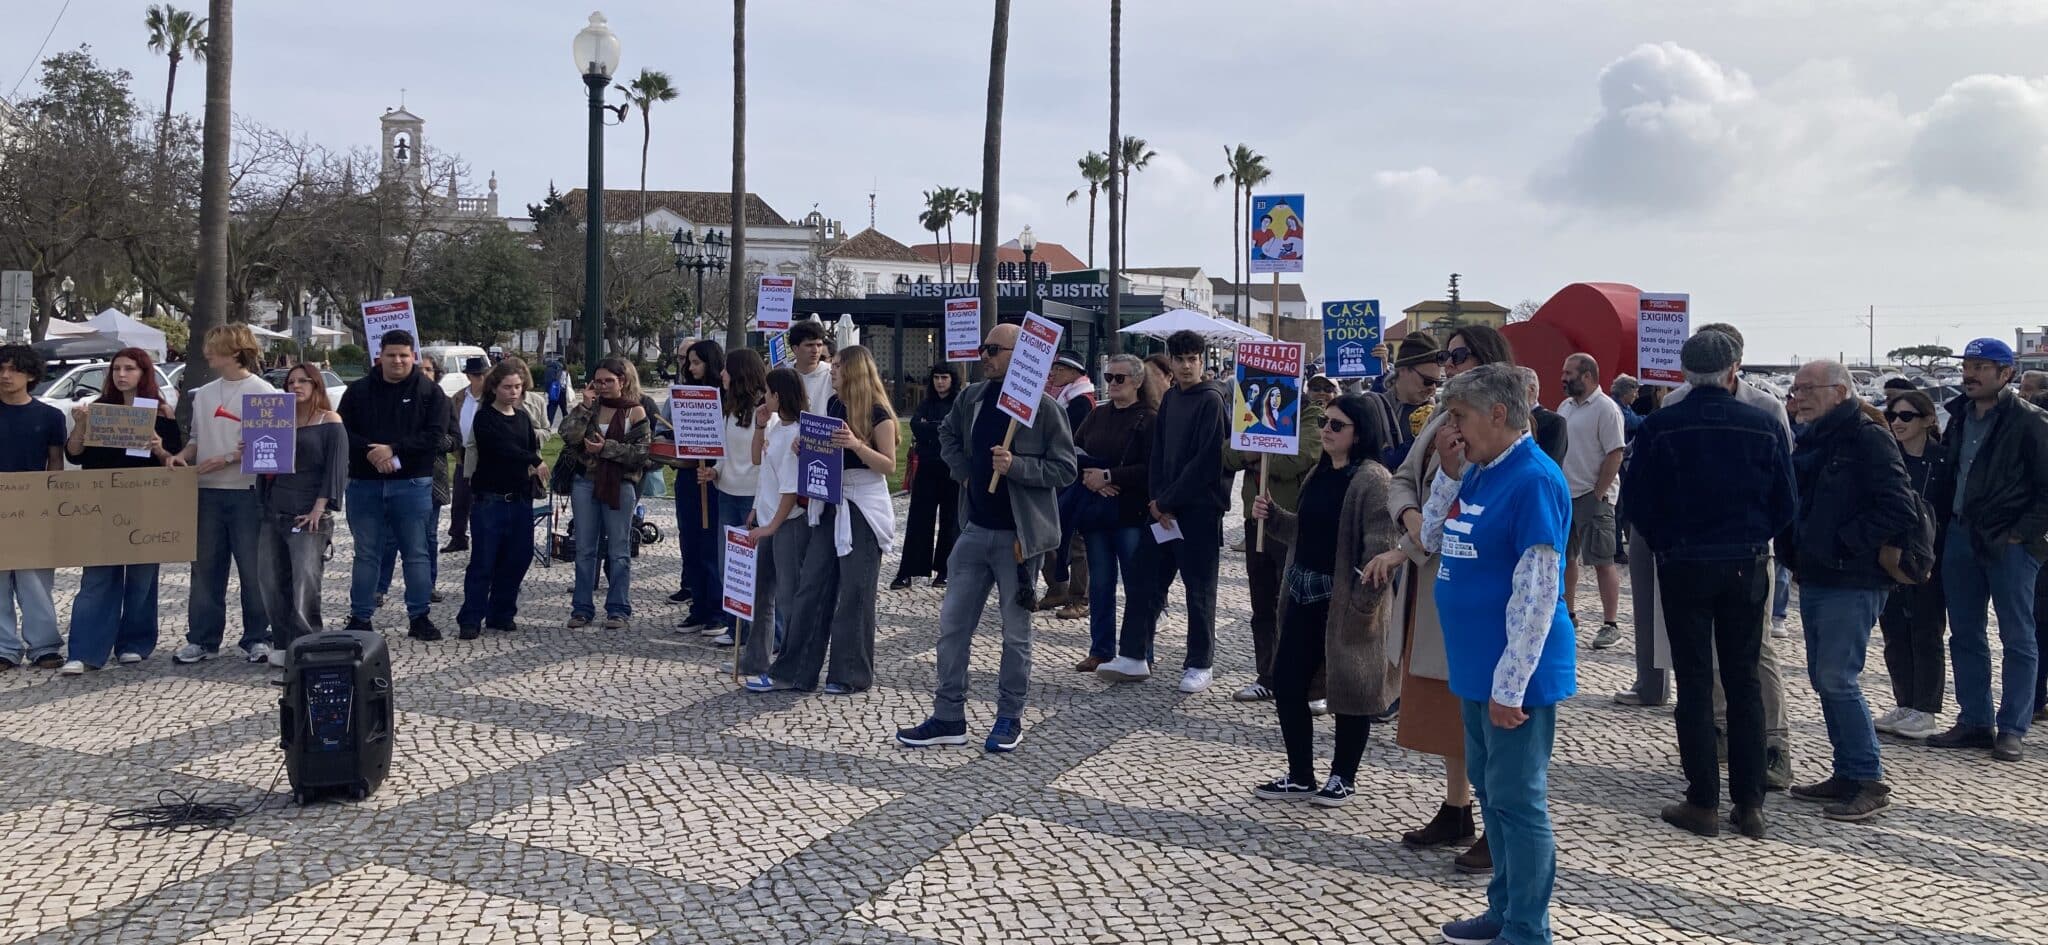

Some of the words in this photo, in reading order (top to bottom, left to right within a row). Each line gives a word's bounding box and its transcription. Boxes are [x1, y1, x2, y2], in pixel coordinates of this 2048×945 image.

[1327, 303, 1375, 318] CASA
[1641, 312, 1684, 323] EXIGIMOS
[368, 312, 409, 324] EXIGIMOS
[1337, 318, 1366, 327] PARA
[1326, 326, 1378, 340] TODOS
[1646, 326, 1672, 334] Diminuir
[1020, 332, 1051, 355] EXIGIMOS
[1022, 349, 1040, 365] Rendas
[1240, 344, 1298, 360] DIREITO
[1239, 353, 1298, 373] HABITAÇÃO
[250, 397, 285, 408] BASTA
[674, 401, 718, 409] EXIGIMOS
[261, 408, 273, 418] DE
[243, 419, 293, 428] DESPEJOS
[58, 502, 103, 517] CASA
[129, 529, 181, 545] COMER
[728, 543, 753, 559] EXIGIMOS
